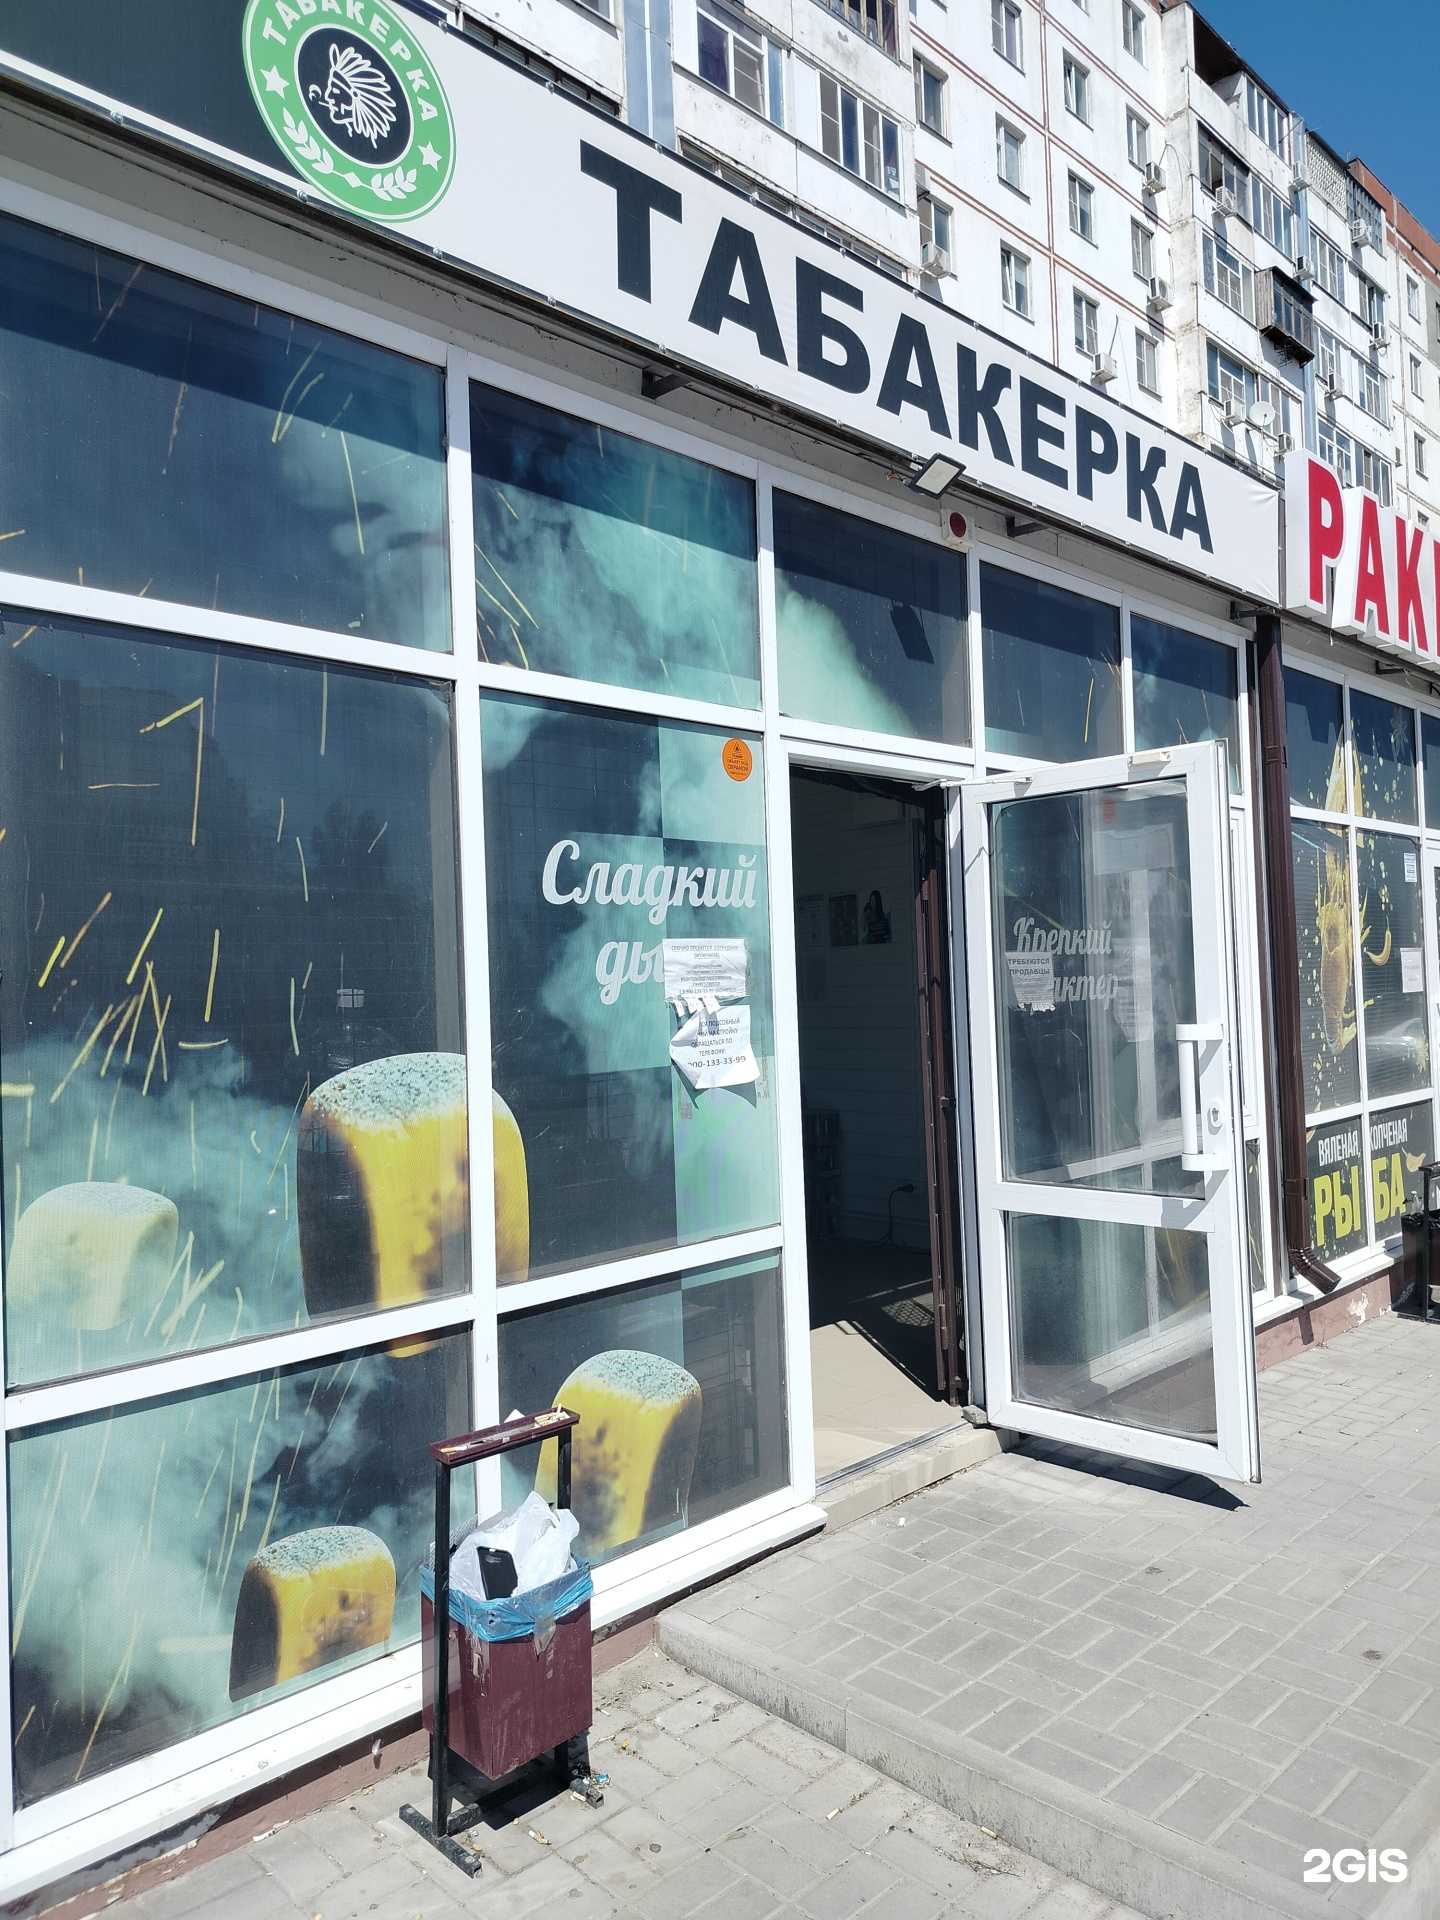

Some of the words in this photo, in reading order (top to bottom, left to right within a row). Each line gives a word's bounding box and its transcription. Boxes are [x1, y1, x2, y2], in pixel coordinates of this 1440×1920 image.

[580, 140, 1214, 554] ТАБАКЕРКА
[542, 839, 757, 925] Сладкий
[1013, 917, 1113, 955] Крепкий
[596, 941, 664, 1005] ды
[1318, 1130, 1361, 1166] ВЯЛЕНАЯ,
[1369, 1118, 1408, 1151] КОПЧЕНАЯ
